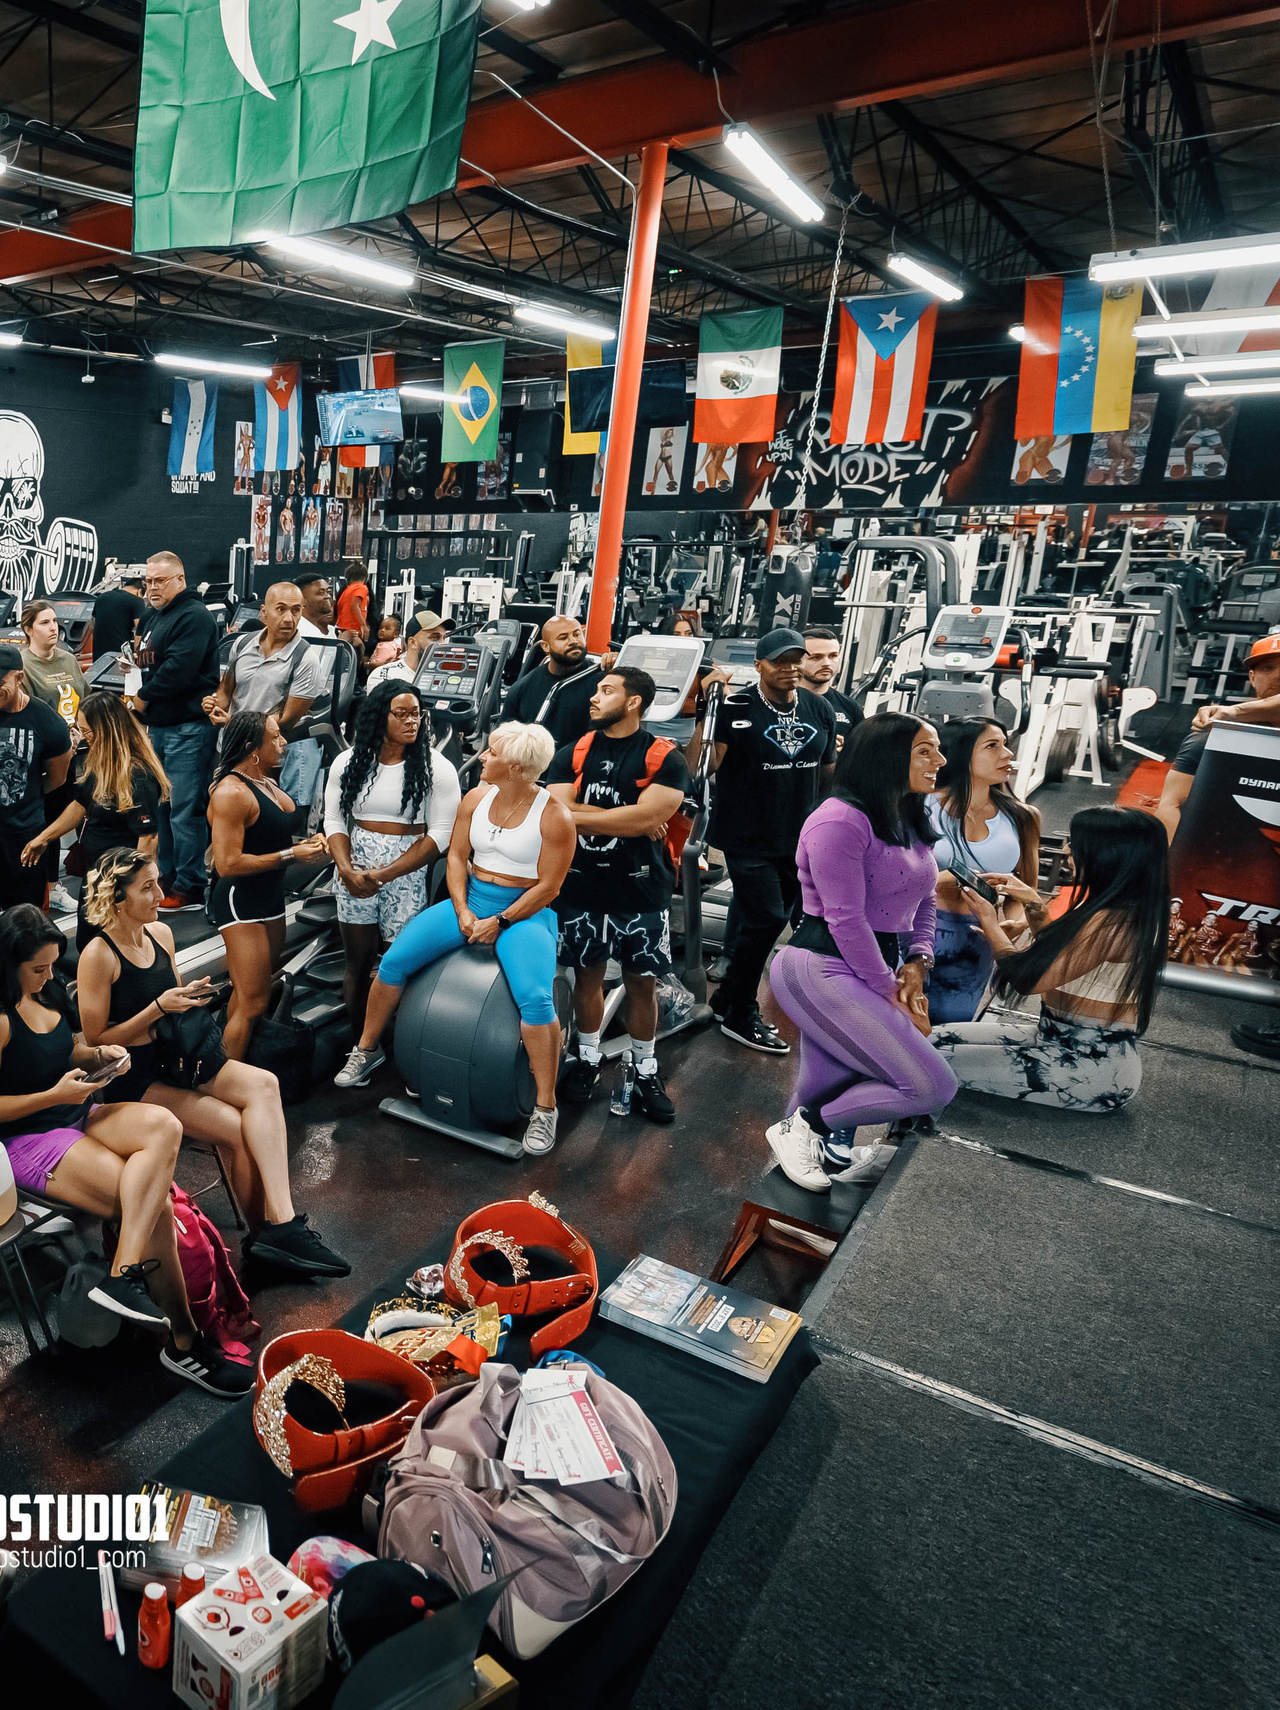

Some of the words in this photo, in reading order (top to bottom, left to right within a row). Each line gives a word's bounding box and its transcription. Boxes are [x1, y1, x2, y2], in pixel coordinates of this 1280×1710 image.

[768, 438, 795, 451] WOKE
[766, 452, 779, 462] UP
[780, 448, 793, 462] IN
[777, 716, 801, 725] NPC
[1201, 892, 1280, 926] TR
[579, 1402, 592, 1419] GIFT
[587, 1418, 615, 1462] CERTIFICATE
